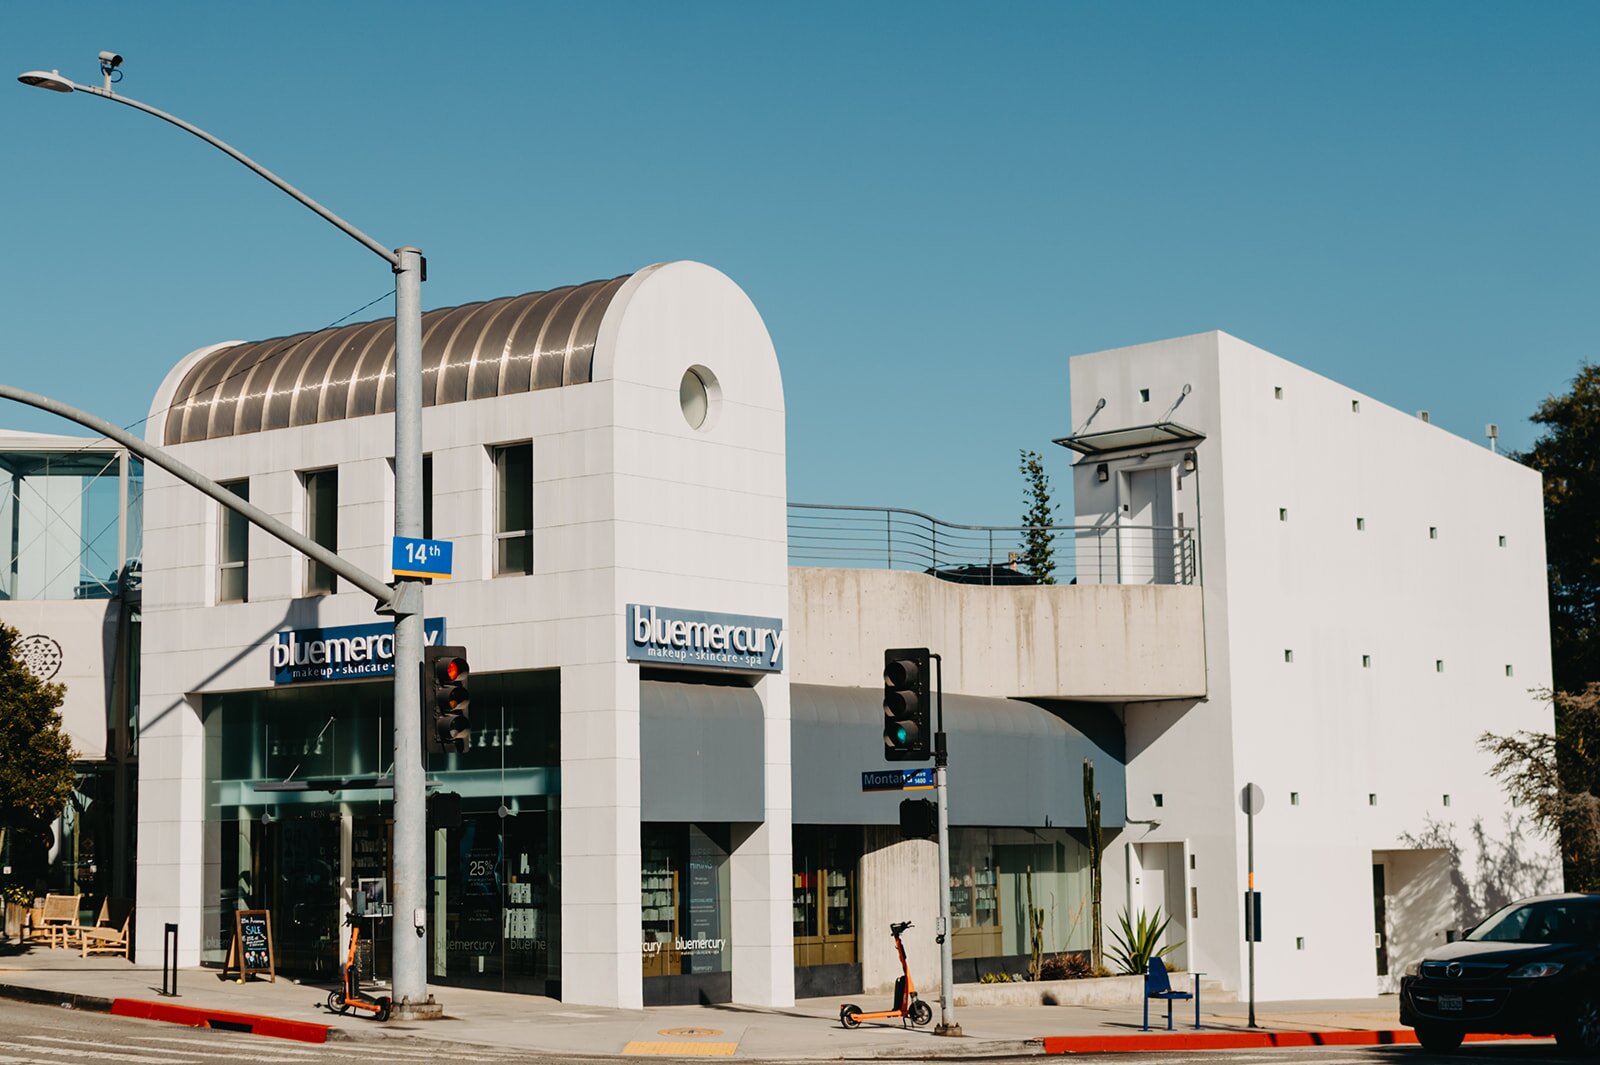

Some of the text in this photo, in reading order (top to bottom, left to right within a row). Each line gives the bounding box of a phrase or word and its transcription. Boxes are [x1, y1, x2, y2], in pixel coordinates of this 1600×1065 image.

[405, 542, 441, 565] 14th
[634, 604, 784, 663] bluemercury
[648, 647, 762, 667] makeup skincare spa
[292, 663, 389, 679] makeup skincare
[864, 773, 913, 785] Montana
[469, 860, 494, 876] 25%
[245, 925, 262, 936] SALE
[675, 936, 726, 952] bluemercury
